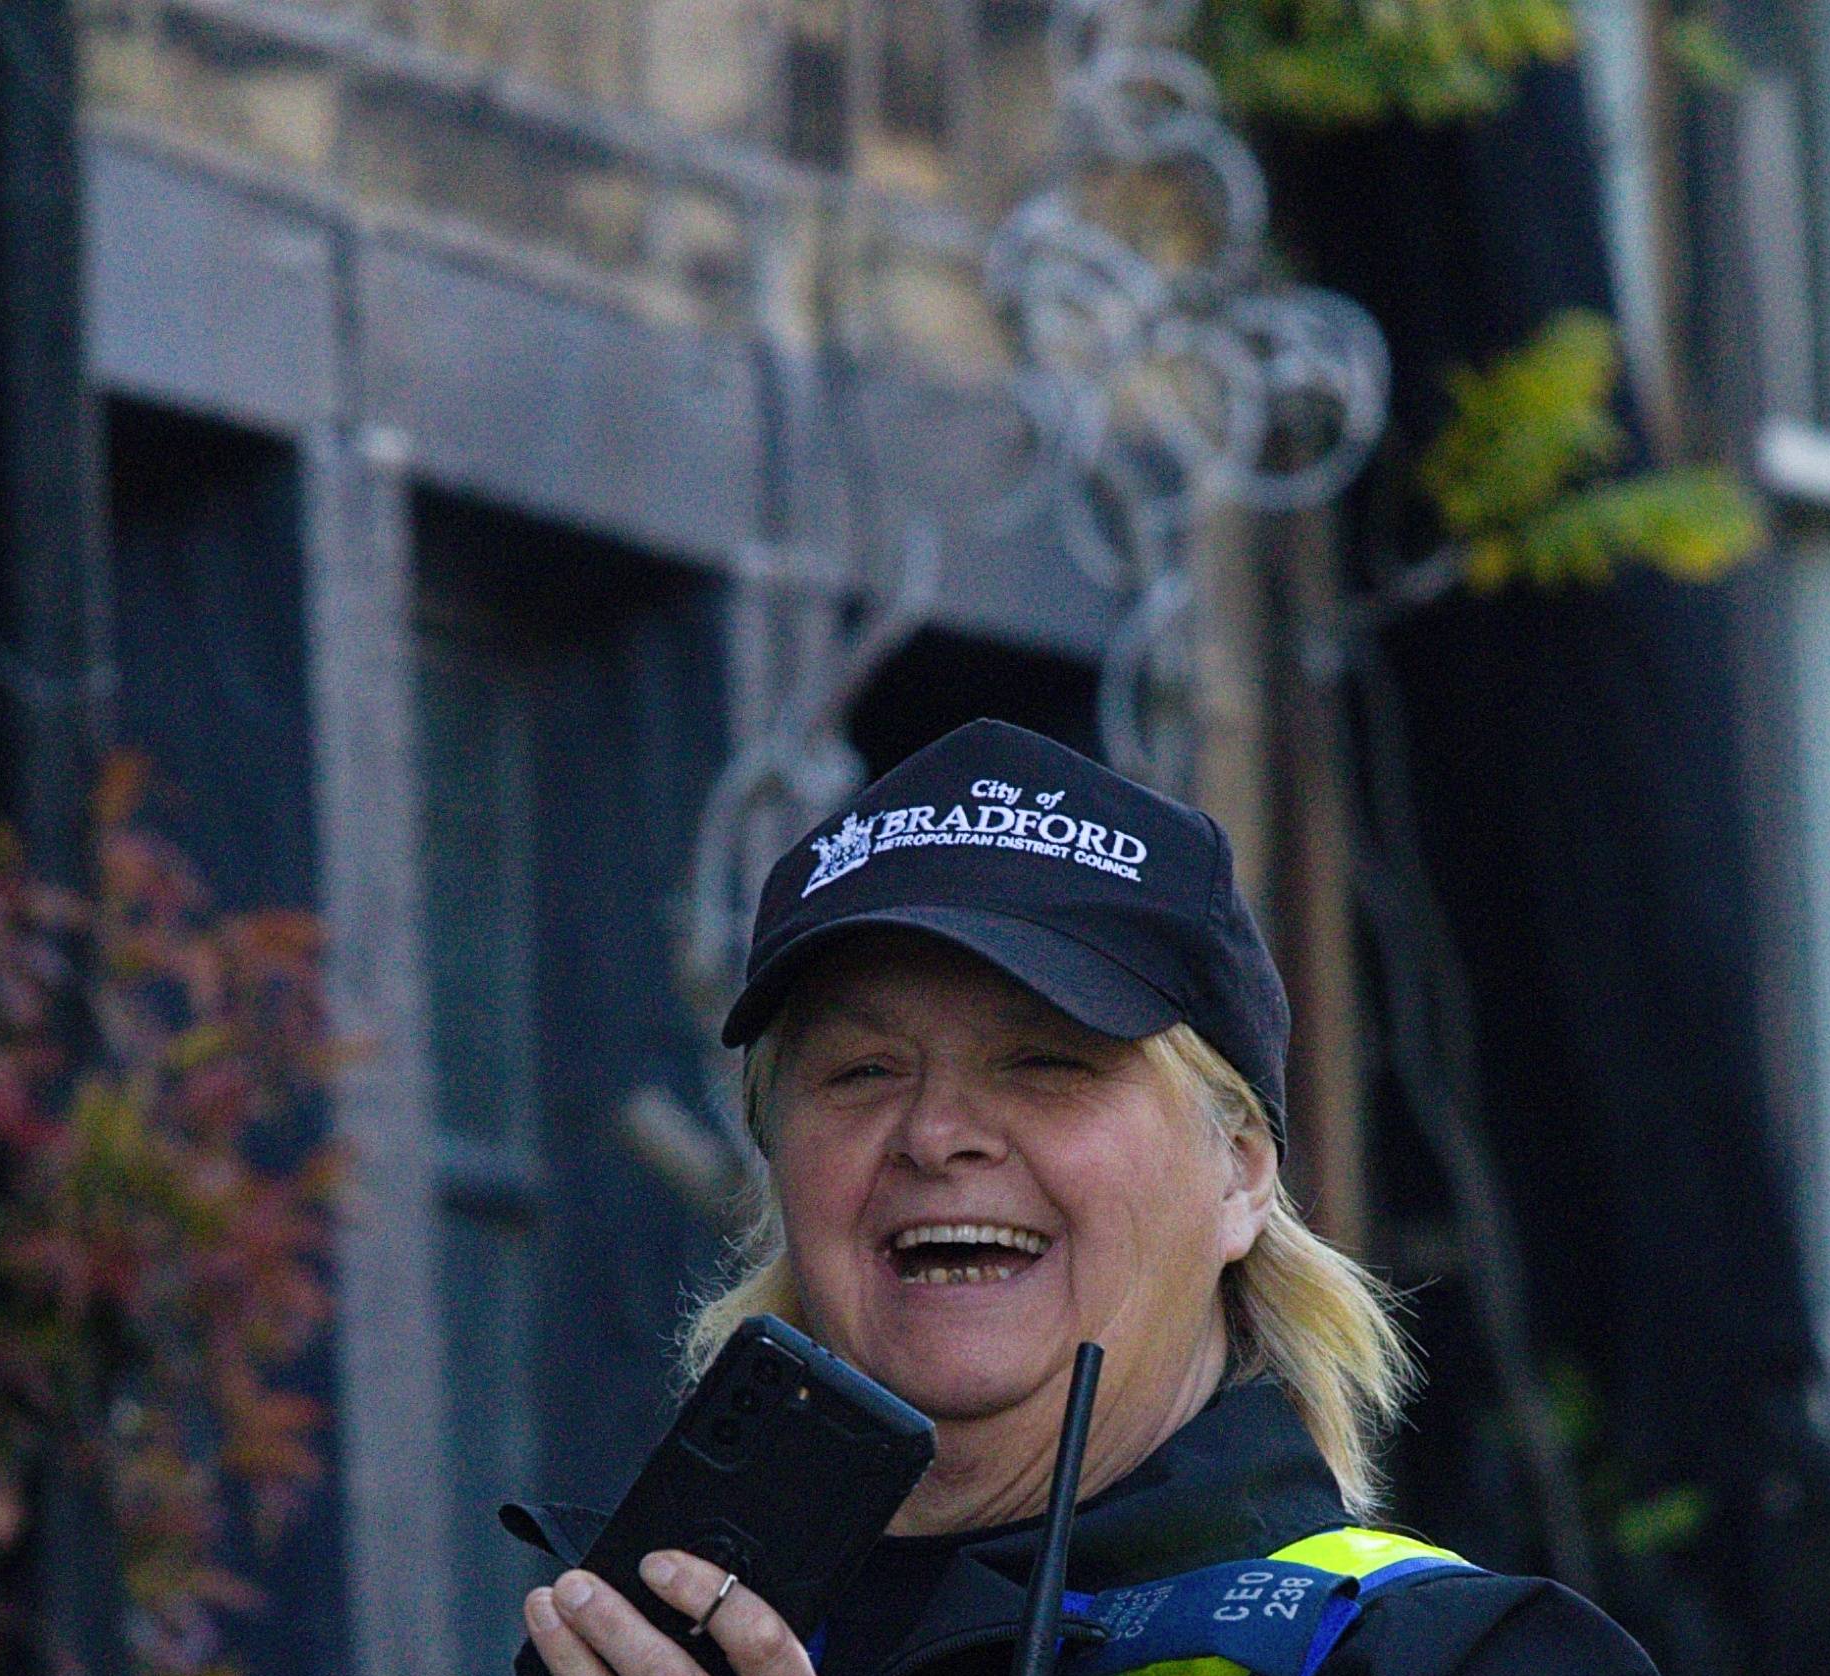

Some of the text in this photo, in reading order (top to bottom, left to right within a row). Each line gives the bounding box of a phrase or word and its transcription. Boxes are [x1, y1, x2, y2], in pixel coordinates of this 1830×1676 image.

[971, 779, 1065, 810] City of
[873, 832, 1142, 882] METROPOLITAN DISTRICT COUNCIL
[875, 804, 1147, 864] BRADFORD
[1213, 1571, 1274, 1622] CEO
[1263, 1576, 1314, 1620] 238
